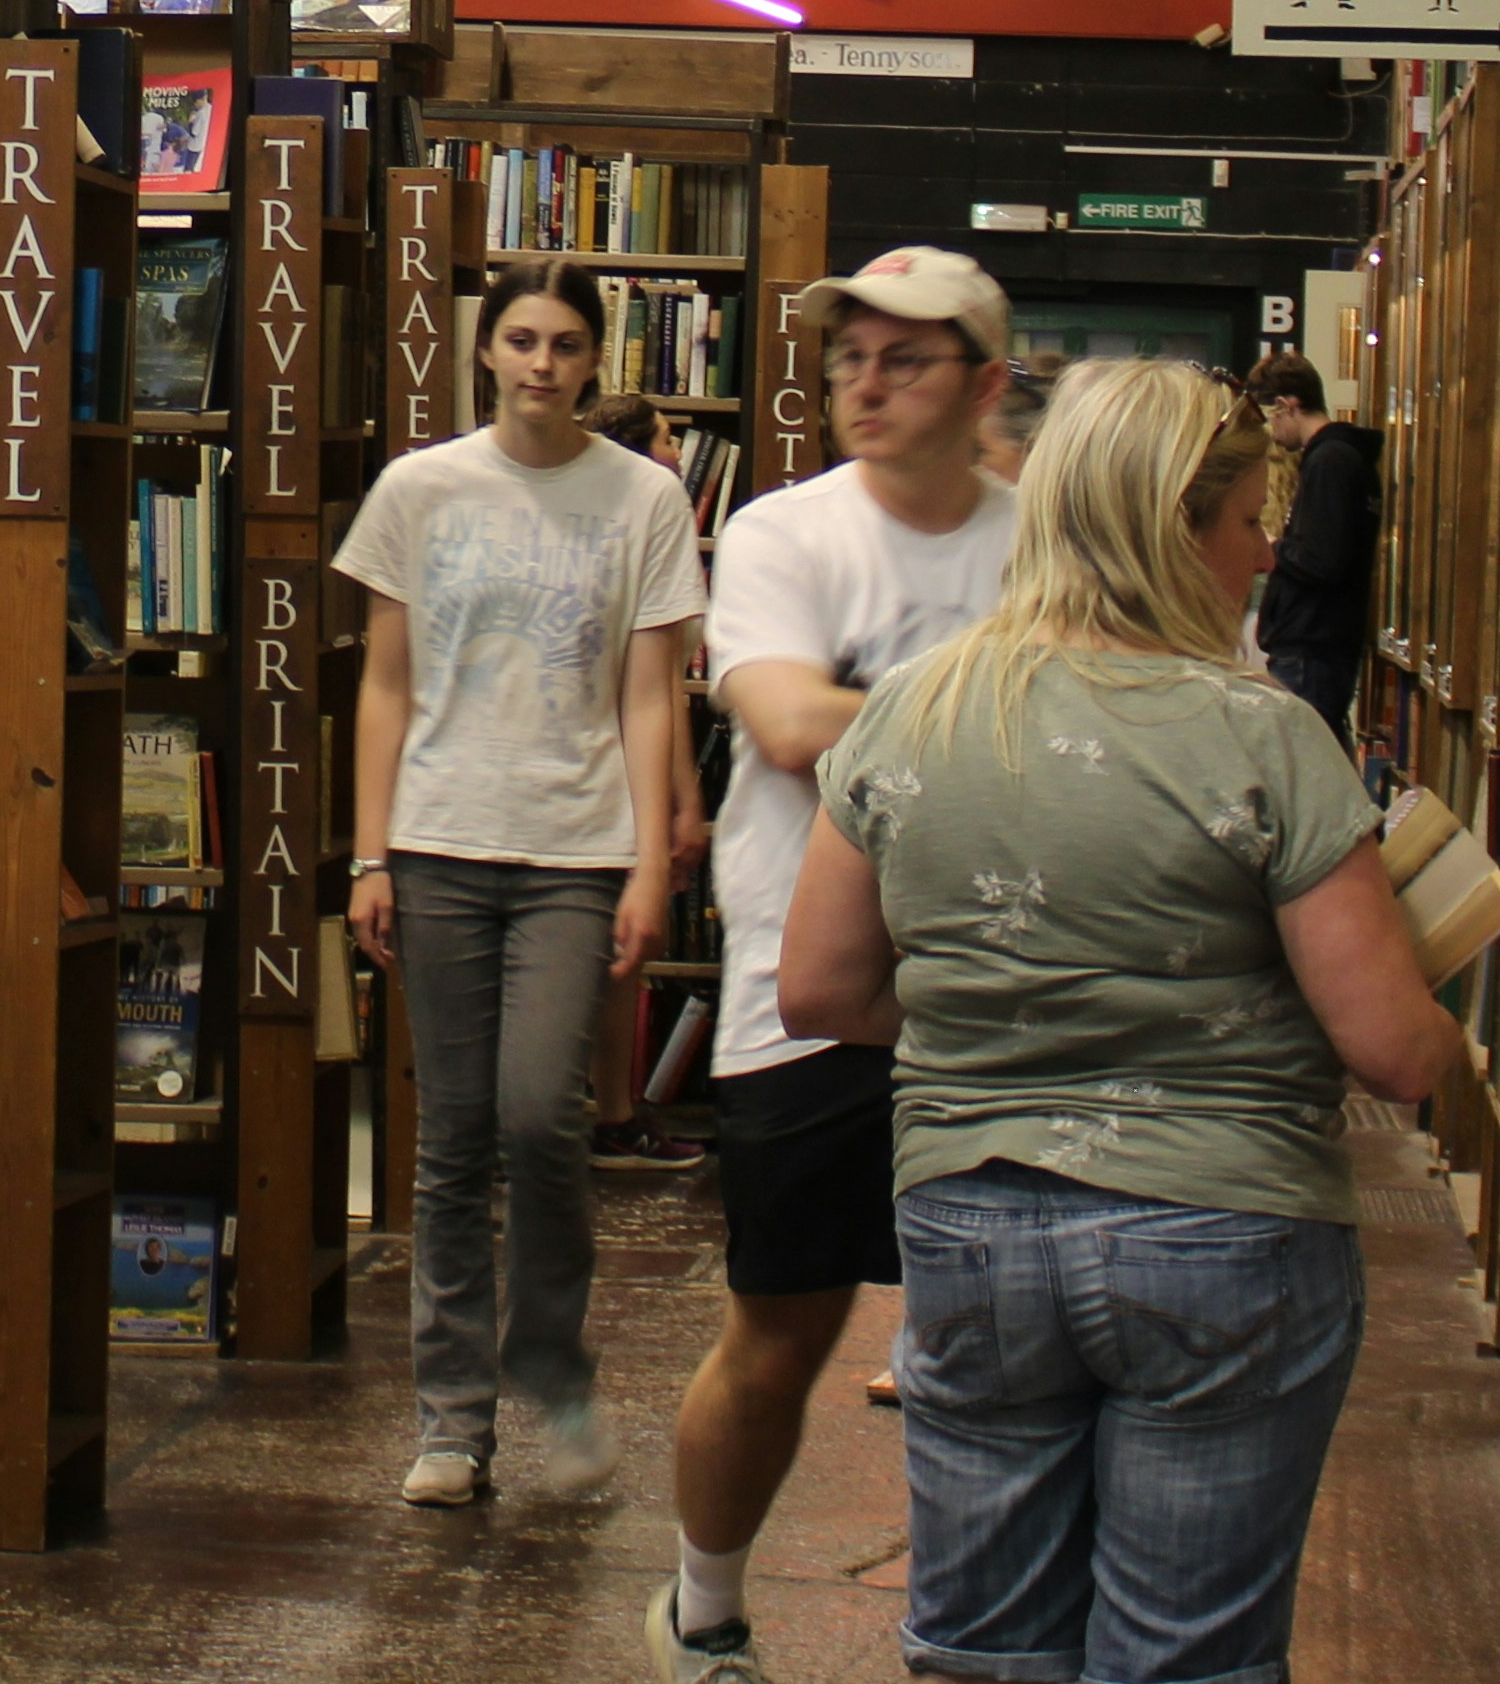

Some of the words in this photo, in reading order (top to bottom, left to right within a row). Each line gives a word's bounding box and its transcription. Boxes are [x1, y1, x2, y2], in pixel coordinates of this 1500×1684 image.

[835, 43, 961, 72] Tennyson.
[142, 85, 188, 98] MOVING
[148, 96, 180, 109] MILES
[1100, 203, 1137, 219] FIRE
[1143, 204, 1181, 221] EXIT
[141, 264, 190, 283] SPAS
[257, 138, 307, 497] TRAVEL
[397, 184, 438, 452] TRAVE
[250, 578, 303, 999] BRITAIN
